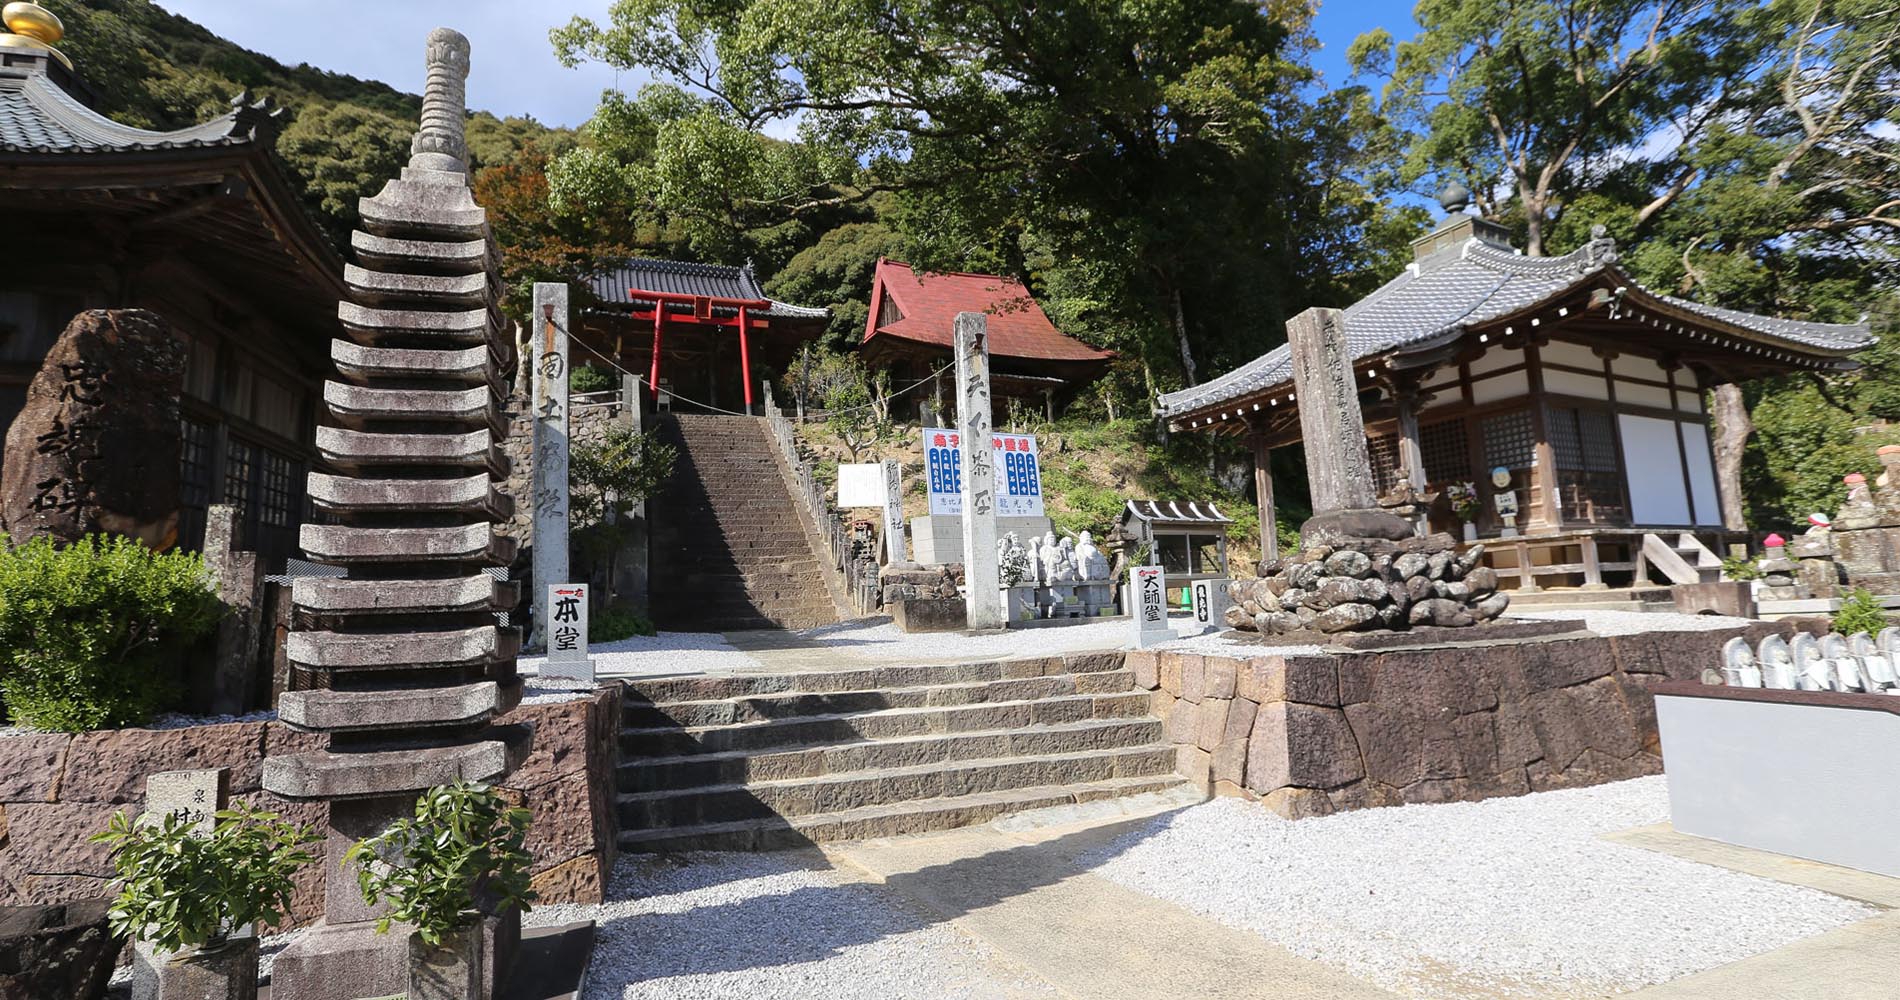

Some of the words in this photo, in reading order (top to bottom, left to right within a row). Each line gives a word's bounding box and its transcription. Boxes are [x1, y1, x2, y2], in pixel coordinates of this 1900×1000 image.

[553, 596, 580, 651] 本堂
[1143, 575, 1161, 622] 大師堂
